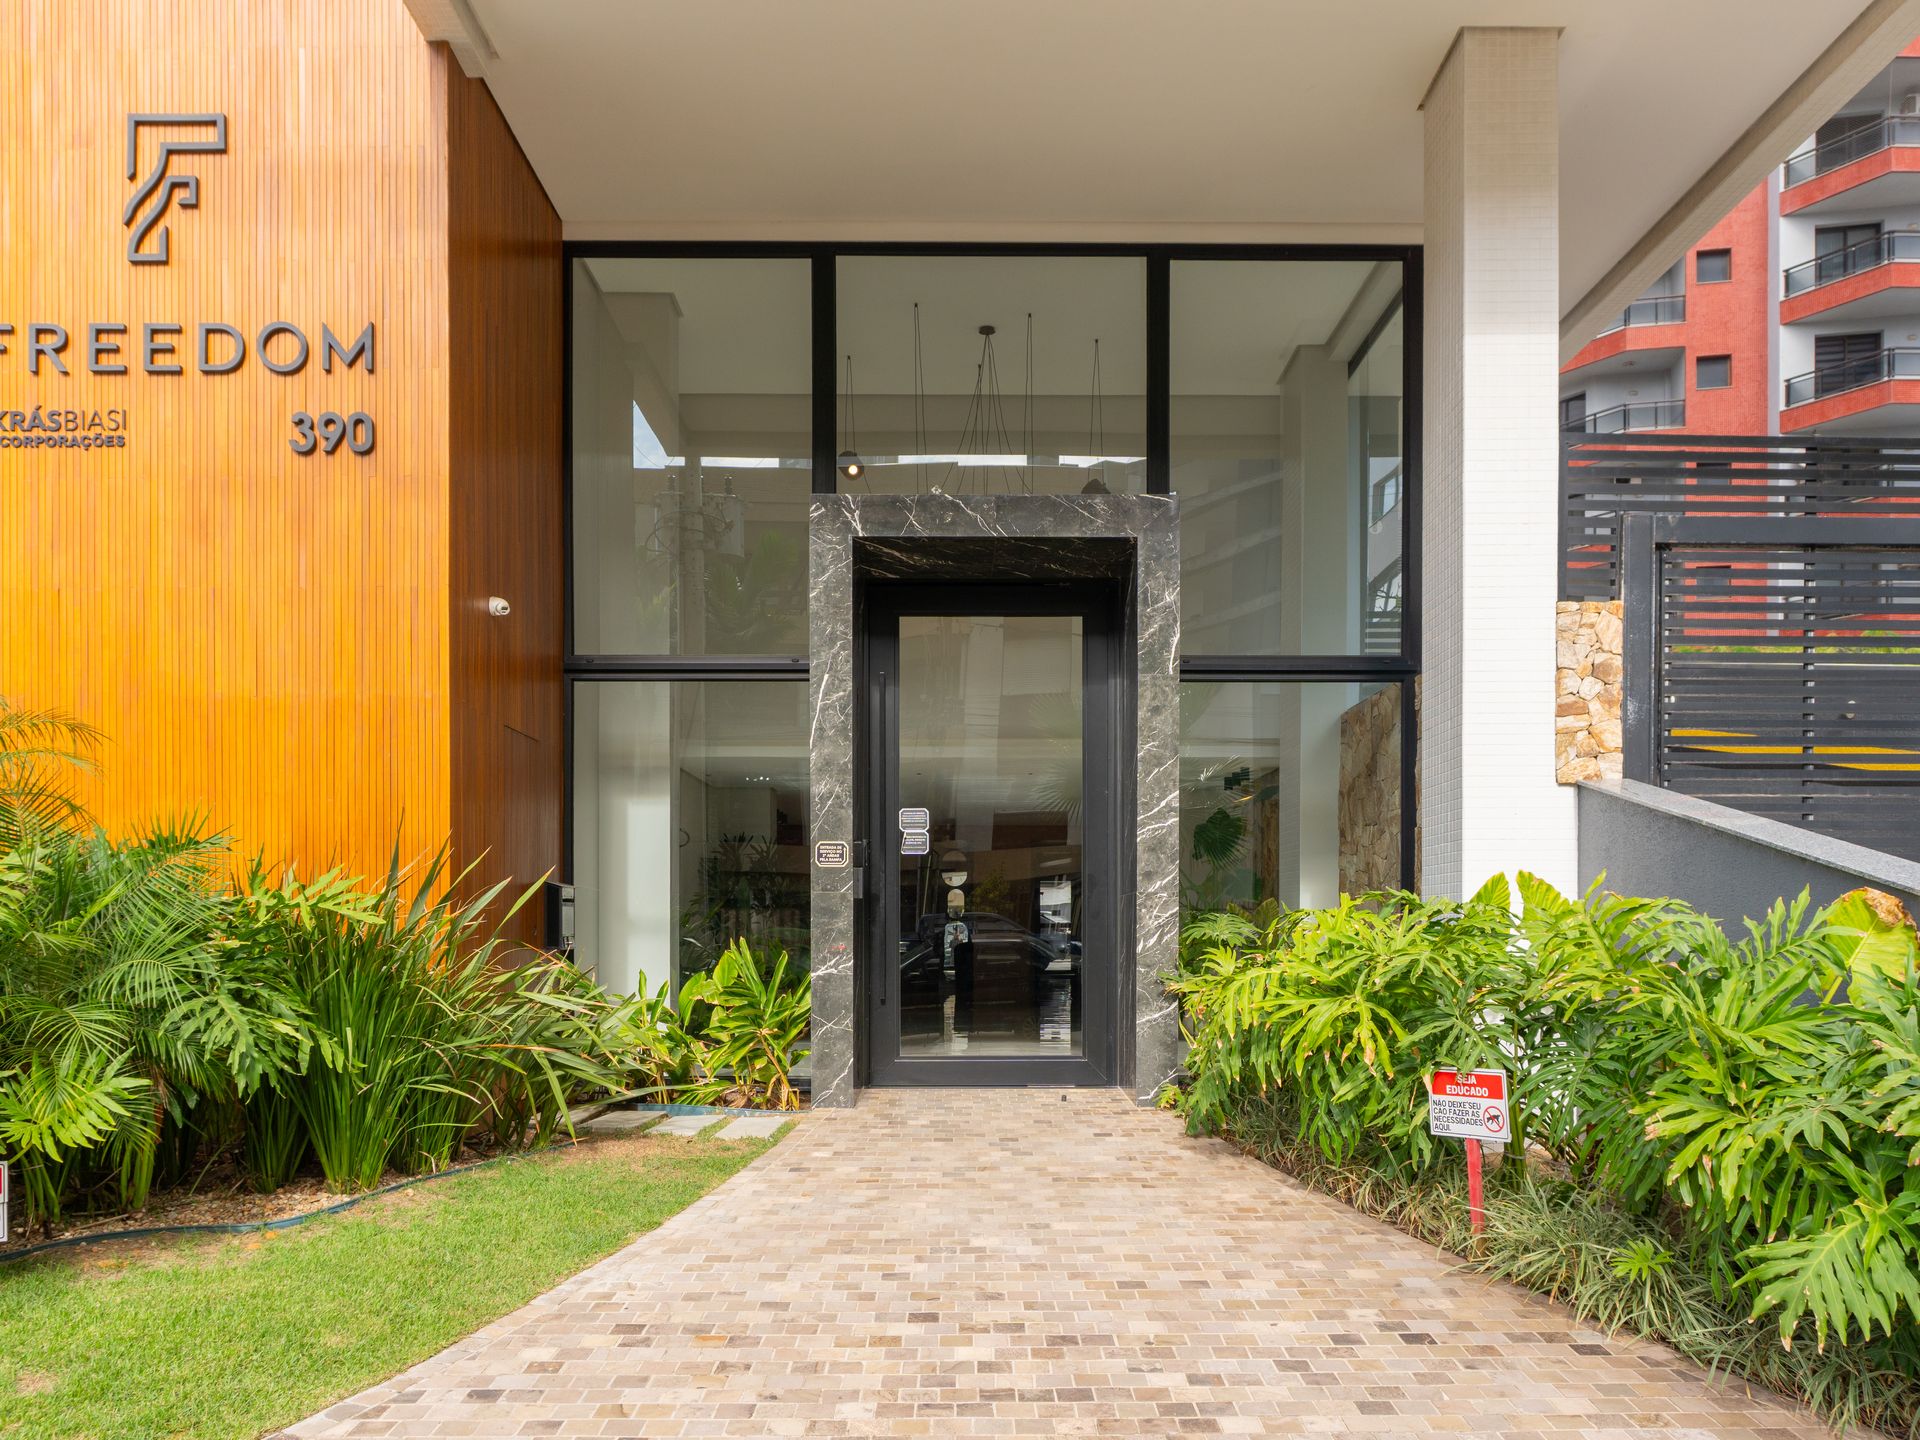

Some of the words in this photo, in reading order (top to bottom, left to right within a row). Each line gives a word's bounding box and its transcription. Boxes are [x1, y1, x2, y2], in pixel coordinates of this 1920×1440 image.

[289, 411, 375, 456] 390
[1457, 1074, 1477, 1084] SEJA
[1446, 1085, 1489, 1097] EDUCADO
[1468, 1102, 1481, 1110] SEU
[1448, 1108, 1470, 1116] FAZER
[1434, 1116, 1484, 1126] NECESSIDADES
